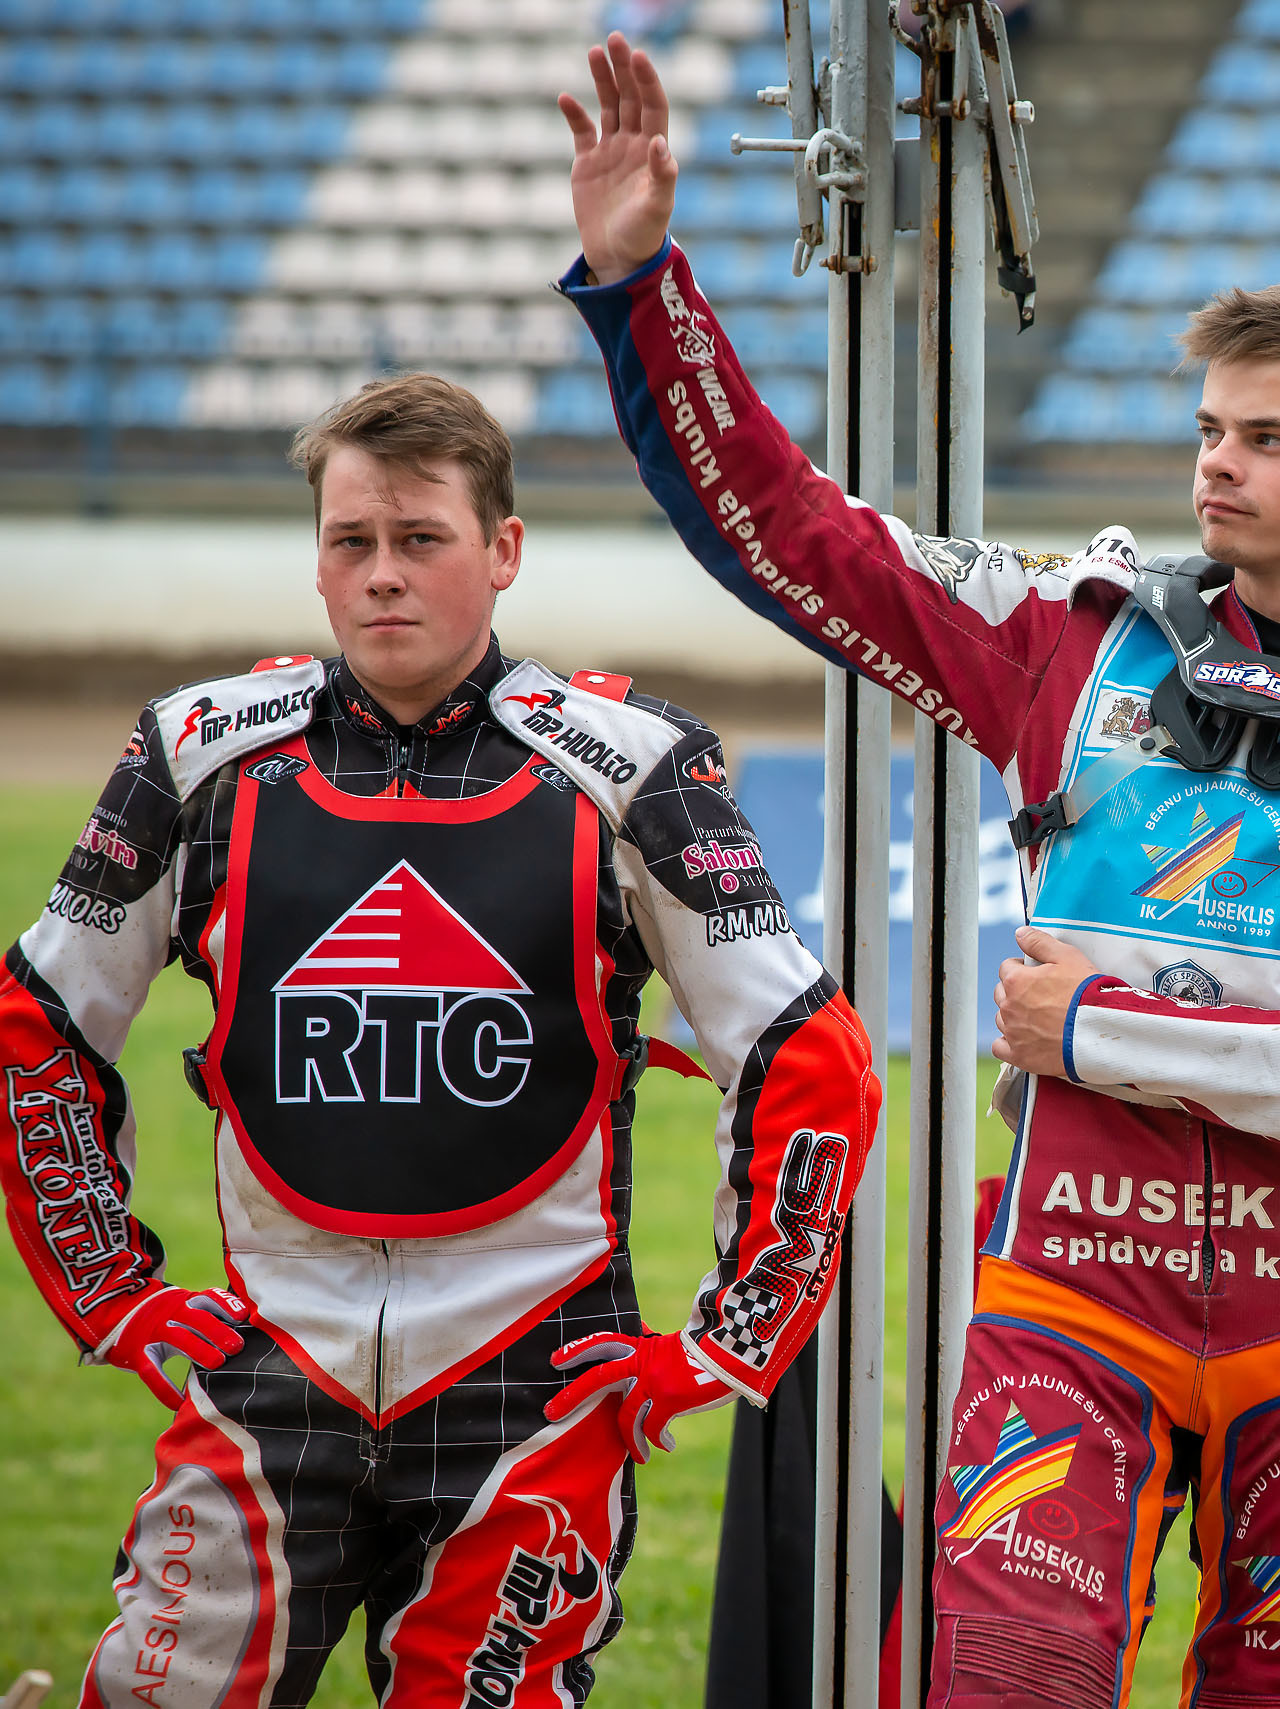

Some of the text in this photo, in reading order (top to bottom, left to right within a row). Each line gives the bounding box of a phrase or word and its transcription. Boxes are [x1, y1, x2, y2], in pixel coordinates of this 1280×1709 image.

[667, 379, 722, 488] klubs
[696, 367, 736, 437] WEAR
[821, 616, 979, 746] AUSEKLIS
[1184, 785, 1204, 798] UN
[1203, 780, 1265, 808] JAUNIEŠU
[1139, 880, 1275, 926] IK AUSEKLIS
[1196, 918, 1272, 938] ANNO 1989
[273, 988, 535, 1109] RTC
[803, 1208, 848, 1305] STORE
[992, 1374, 1015, 1394] UN
[1018, 1373, 1105, 1424] JAUNIEŠU
[1102, 1426, 1126, 1503] CENTRS
[952, 1506, 1106, 1594] AUSEKLIS
[1000, 1560, 1062, 1585] ANNO
[1244, 1629, 1268, 1650] IK
